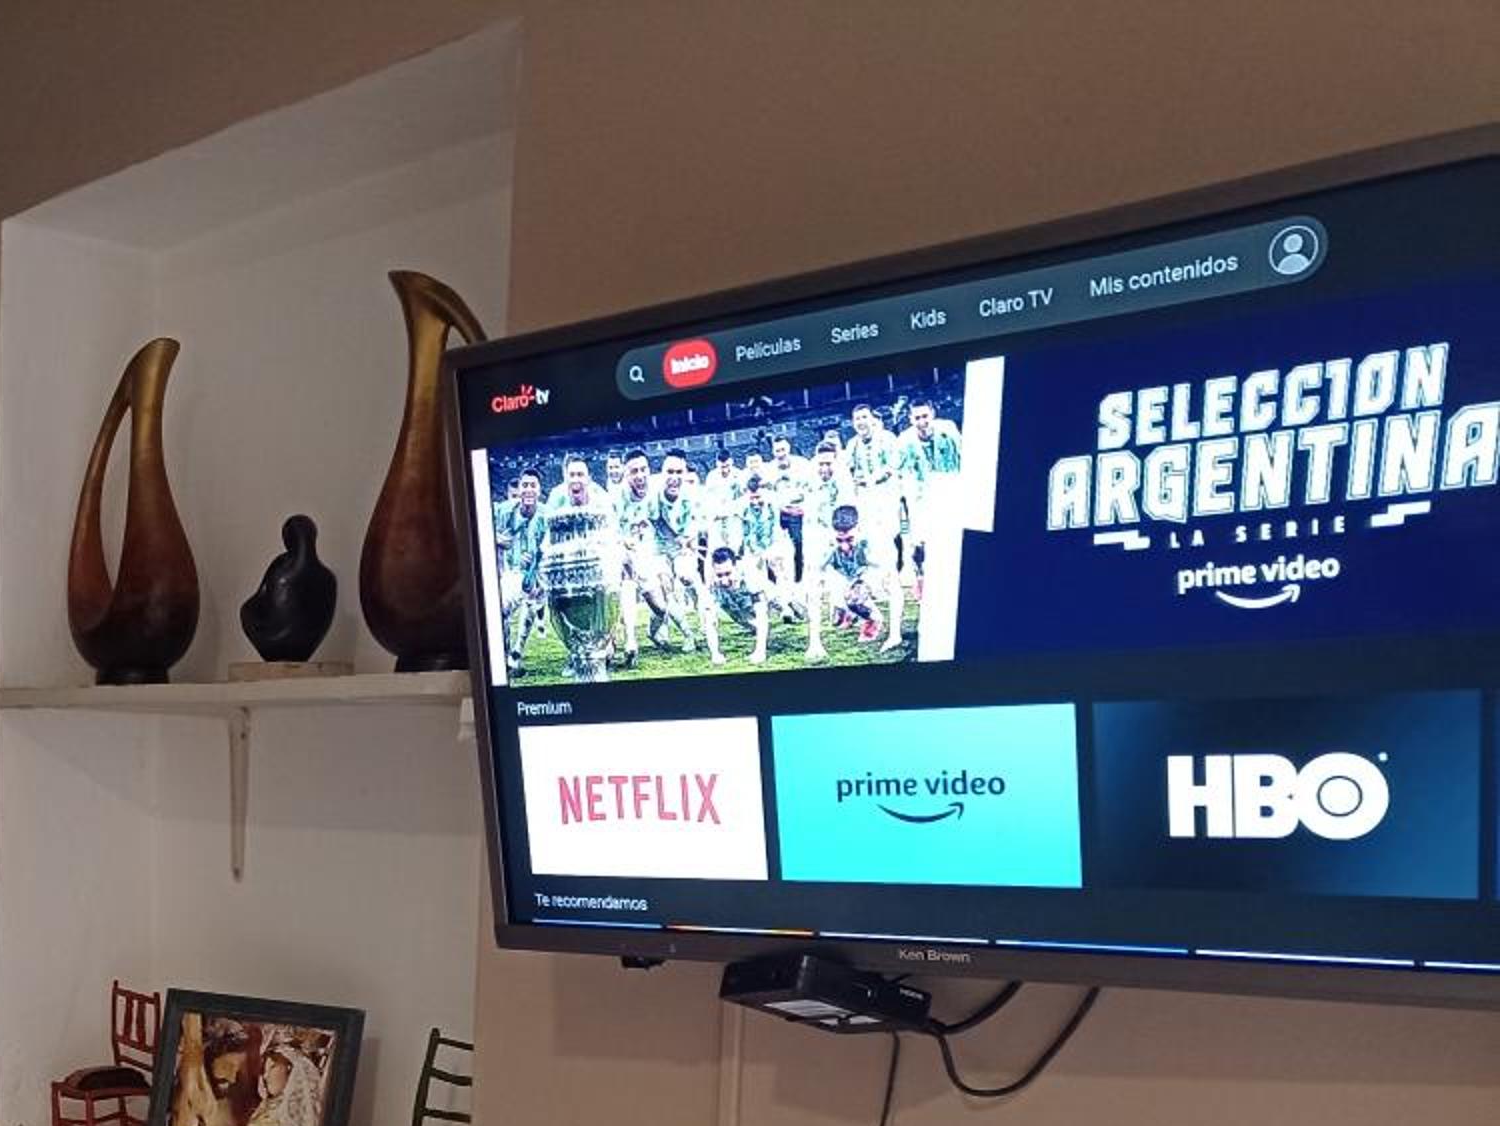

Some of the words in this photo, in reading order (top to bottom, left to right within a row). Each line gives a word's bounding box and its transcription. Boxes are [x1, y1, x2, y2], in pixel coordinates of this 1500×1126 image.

[1090, 276, 1124, 297] Mis
[1129, 255, 1239, 290] contenidos
[979, 296, 1024, 317] Claro
[1028, 287, 1053, 306] TV
[831, 323, 879, 344] Series
[911, 309, 947, 330] Kids
[670, 355, 709, 375] Inicio
[535, 387, 550, 405] tv
[1047, 401, 1500, 531] ARGENTINA
[1169, 530, 1205, 549] LA
[1235, 516, 1345, 543] SERIE
[1177, 564, 1257, 594] prime
[1260, 554, 1340, 582] video
[517, 700, 572, 717] Premium
[558, 773, 721, 825] NETFLIX
[836, 772, 918, 802] prime
[924, 769, 1006, 795] video
[1167, 752, 1390, 840] HBO
[534, 893, 550, 907] Te
[552, 894, 648, 911] recomendamos
[899, 948, 925, 961] Ken
[927, 949, 971, 963] Brown
